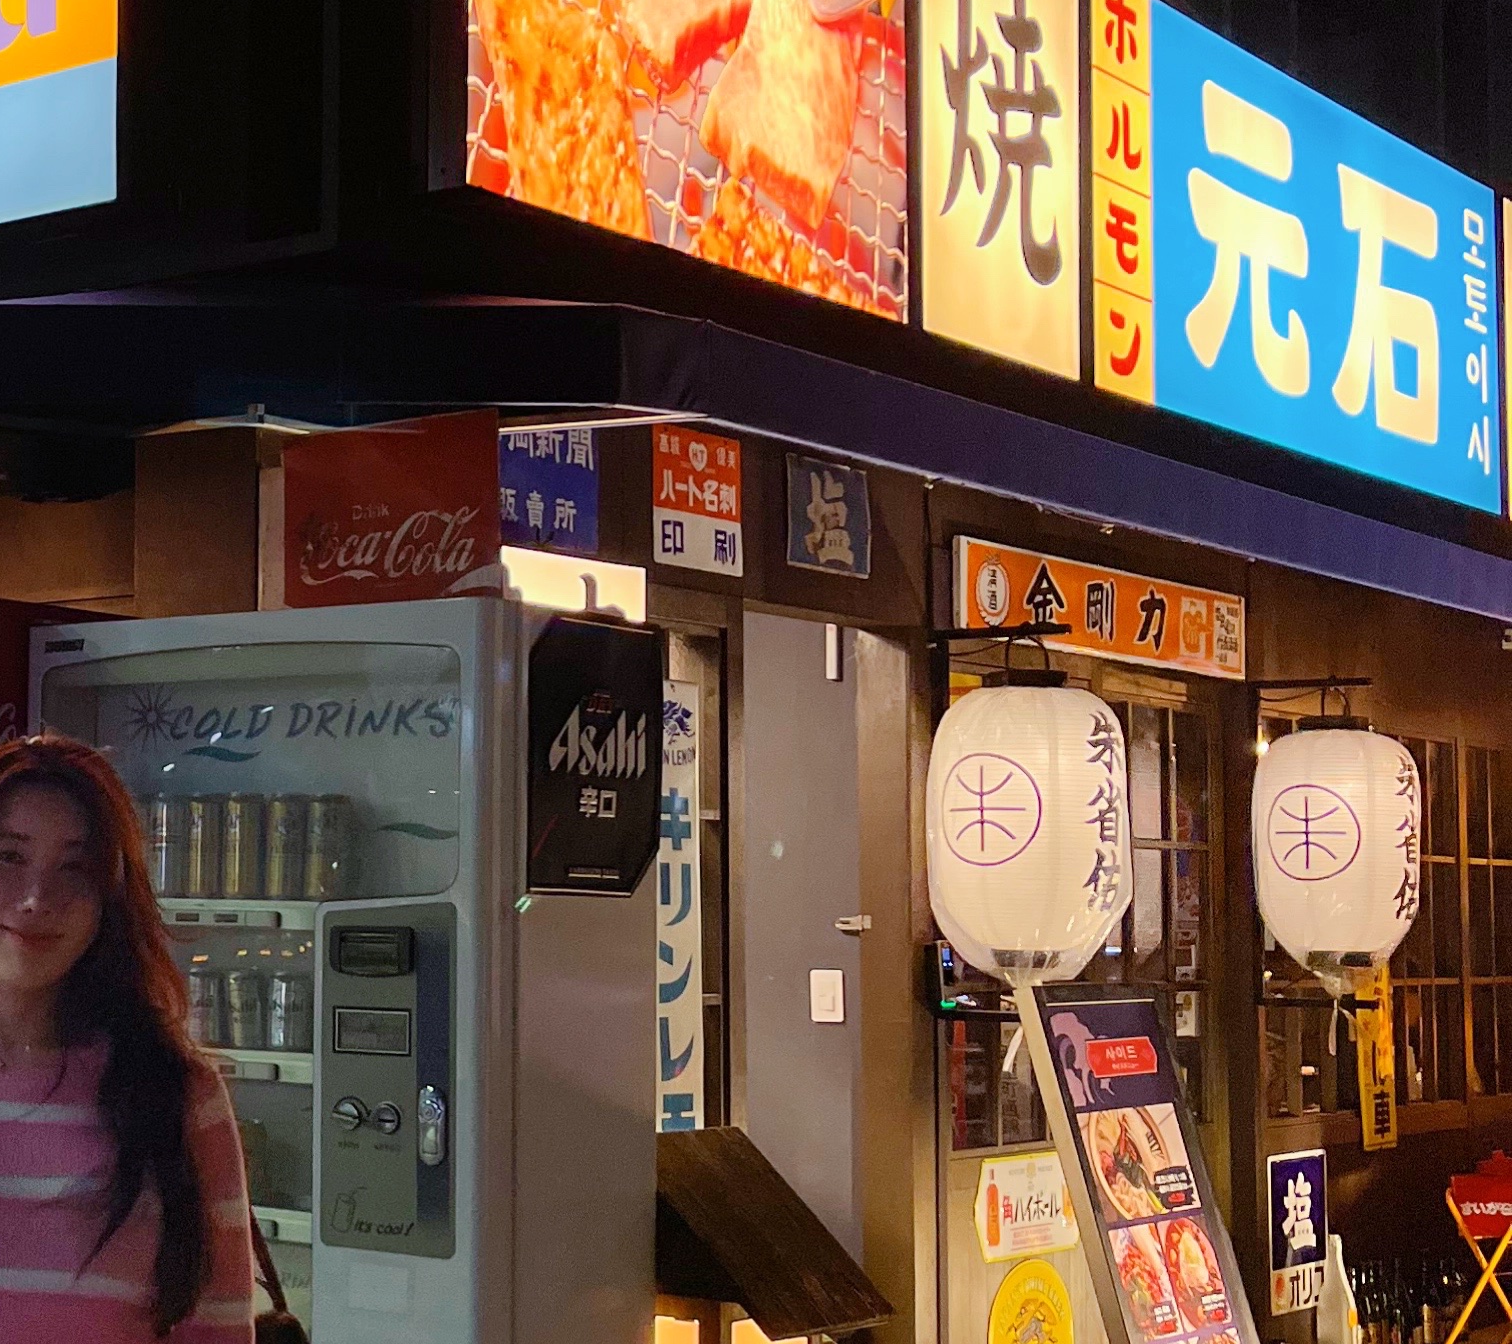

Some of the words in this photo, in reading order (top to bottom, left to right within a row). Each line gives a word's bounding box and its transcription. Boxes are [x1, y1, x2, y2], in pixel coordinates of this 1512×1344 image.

[1184, 78, 1441, 445] 元石
[1463, 207, 1490, 476] 모토이시
[660, 469, 737, 516] ハート名刺
[299, 505, 481, 586] Coca-Cola
[661, 520, 737, 566] 印刷
[170, 703, 277, 741] COLD
[285, 696, 456, 739] DRINKS
[549, 704, 647, 780] Asahi
[1002, 1189, 1062, 1226] 角ハイボール
